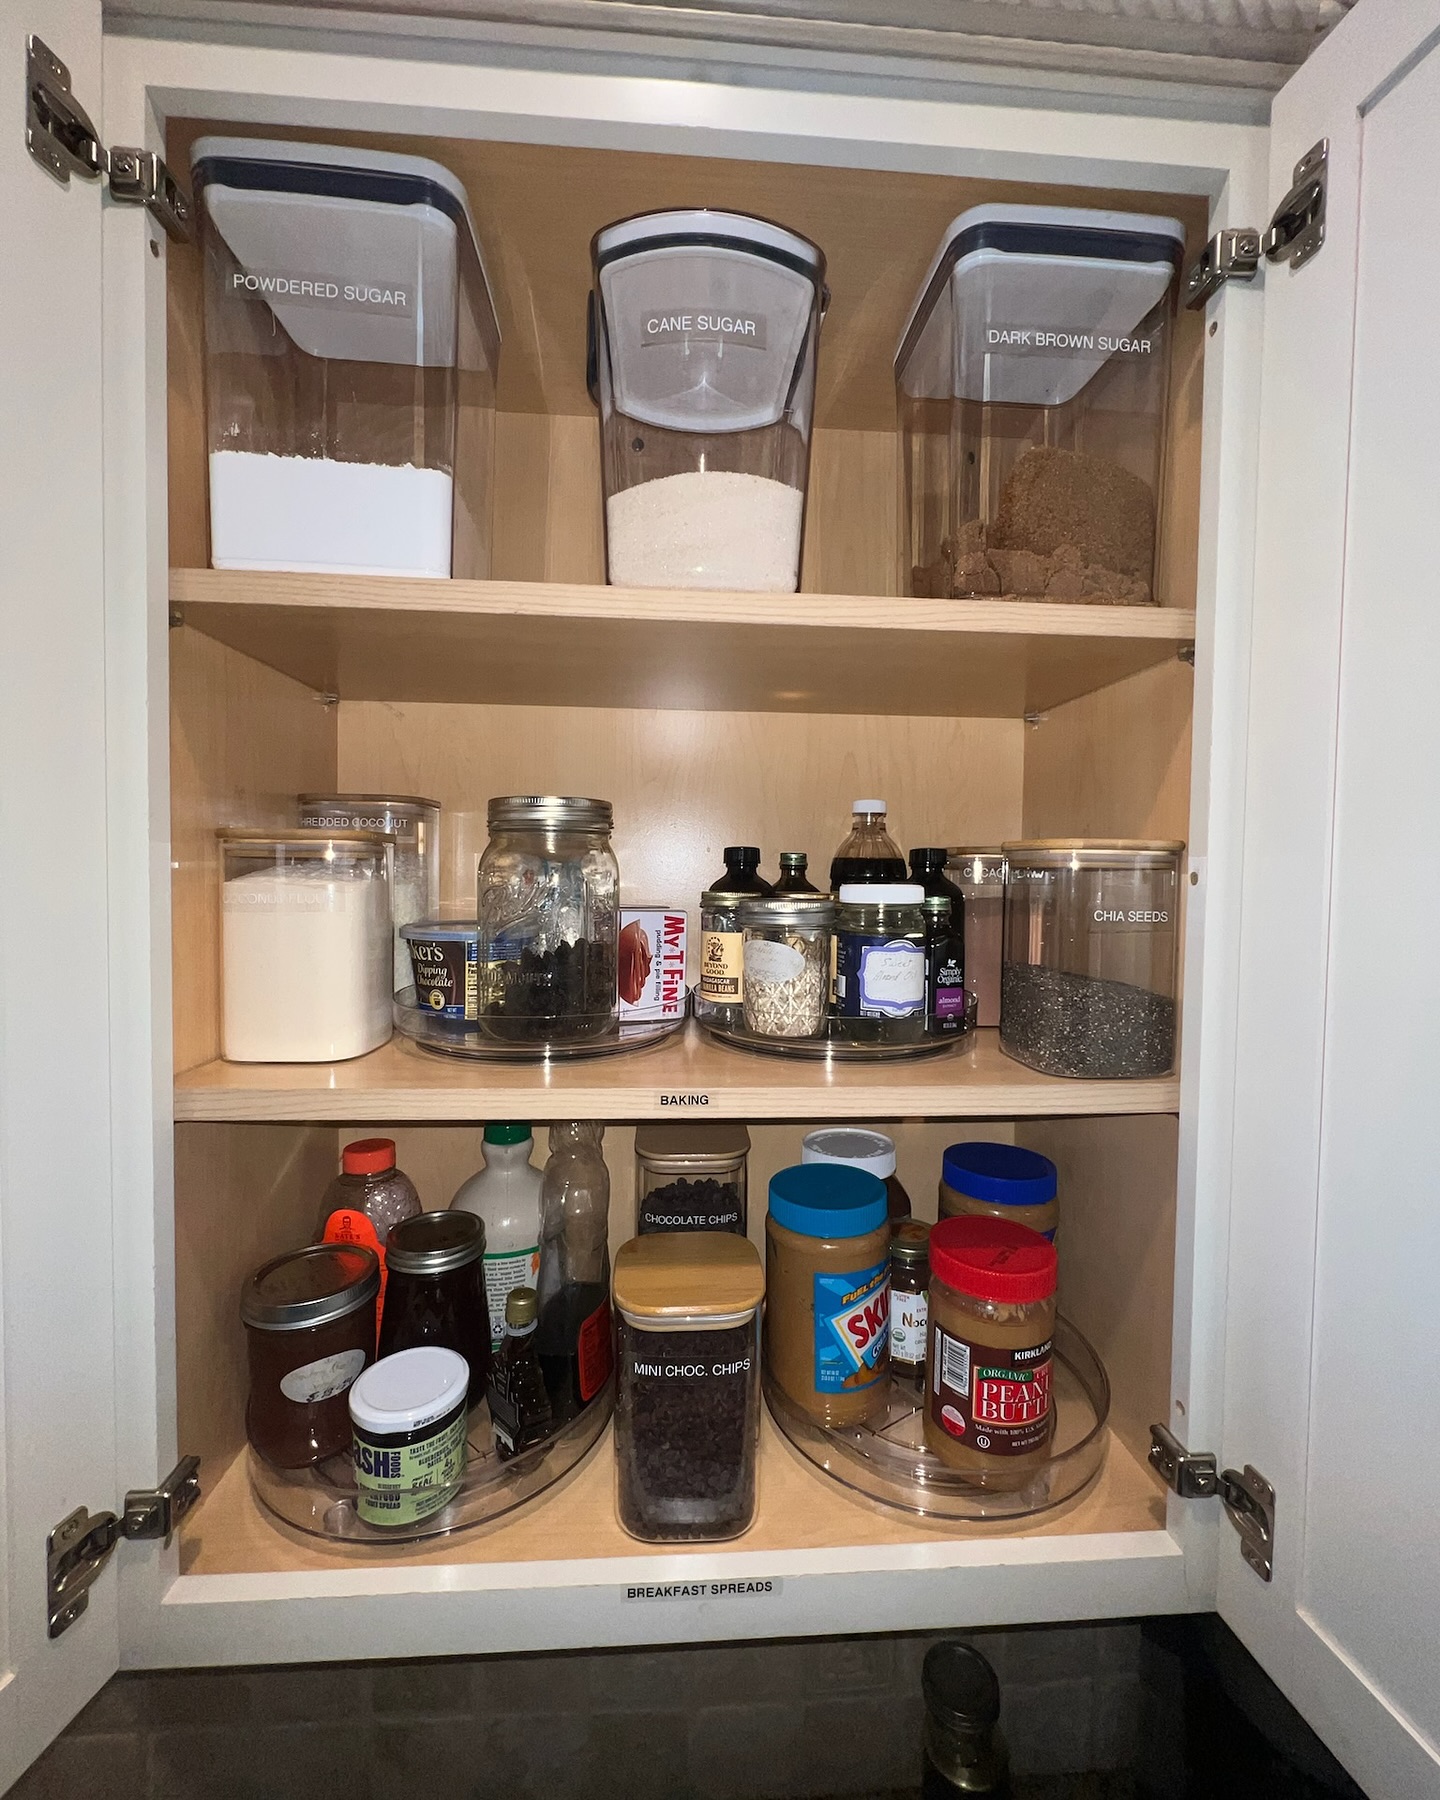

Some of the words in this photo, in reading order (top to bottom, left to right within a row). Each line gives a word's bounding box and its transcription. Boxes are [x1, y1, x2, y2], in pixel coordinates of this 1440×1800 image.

[233, 274, 338, 298] POWDERED
[344, 286, 406, 306] SUGAR
[647, 316, 692, 334] CANE
[697, 315, 756, 336] SUGAR
[988, 329, 1031, 345] DARK
[1035, 332, 1094, 349] BROWN
[1098, 337, 1151, 353] SUGAR
[300, 817, 349, 828] HREDDED
[963, 867, 1003, 878] CCAO
[1094, 910, 1125, 922] CHIA
[1128, 911, 1168, 923] SEEDS
[410, 939, 444, 961] ker's
[654, 930, 662, 958] pudding
[663, 951, 685, 964] T
[418, 963, 447, 979] Dipping
[654, 968, 662, 979] pie
[940, 967, 962, 977] Simply
[417, 975, 454, 988] Chocolate
[937, 976, 963, 986] Organic
[939, 996, 961, 1004] almond
[660, 1095, 709, 1105] BAKING
[645, 1212, 706, 1225] CHOCOLATE
[708, 1212, 738, 1225] CHIPS
[842, 1285, 869, 1305] FUEL
[1014, 1340, 1052, 1360] KIRKLAND
[634, 1362, 662, 1377] MINI
[665, 1365, 708, 1377] CHOC.
[712, 1358, 751, 1377] CHIPS
[983, 1369, 1029, 1381] ORGANIC
[982, 1393, 1048, 1421] BUTT
[975, 1424, 993, 1433] Made
[391, 1452, 401, 1478] FOODS
[627, 1585, 707, 1598] BREAKFAST
[711, 1581, 773, 1595] SPREADS
